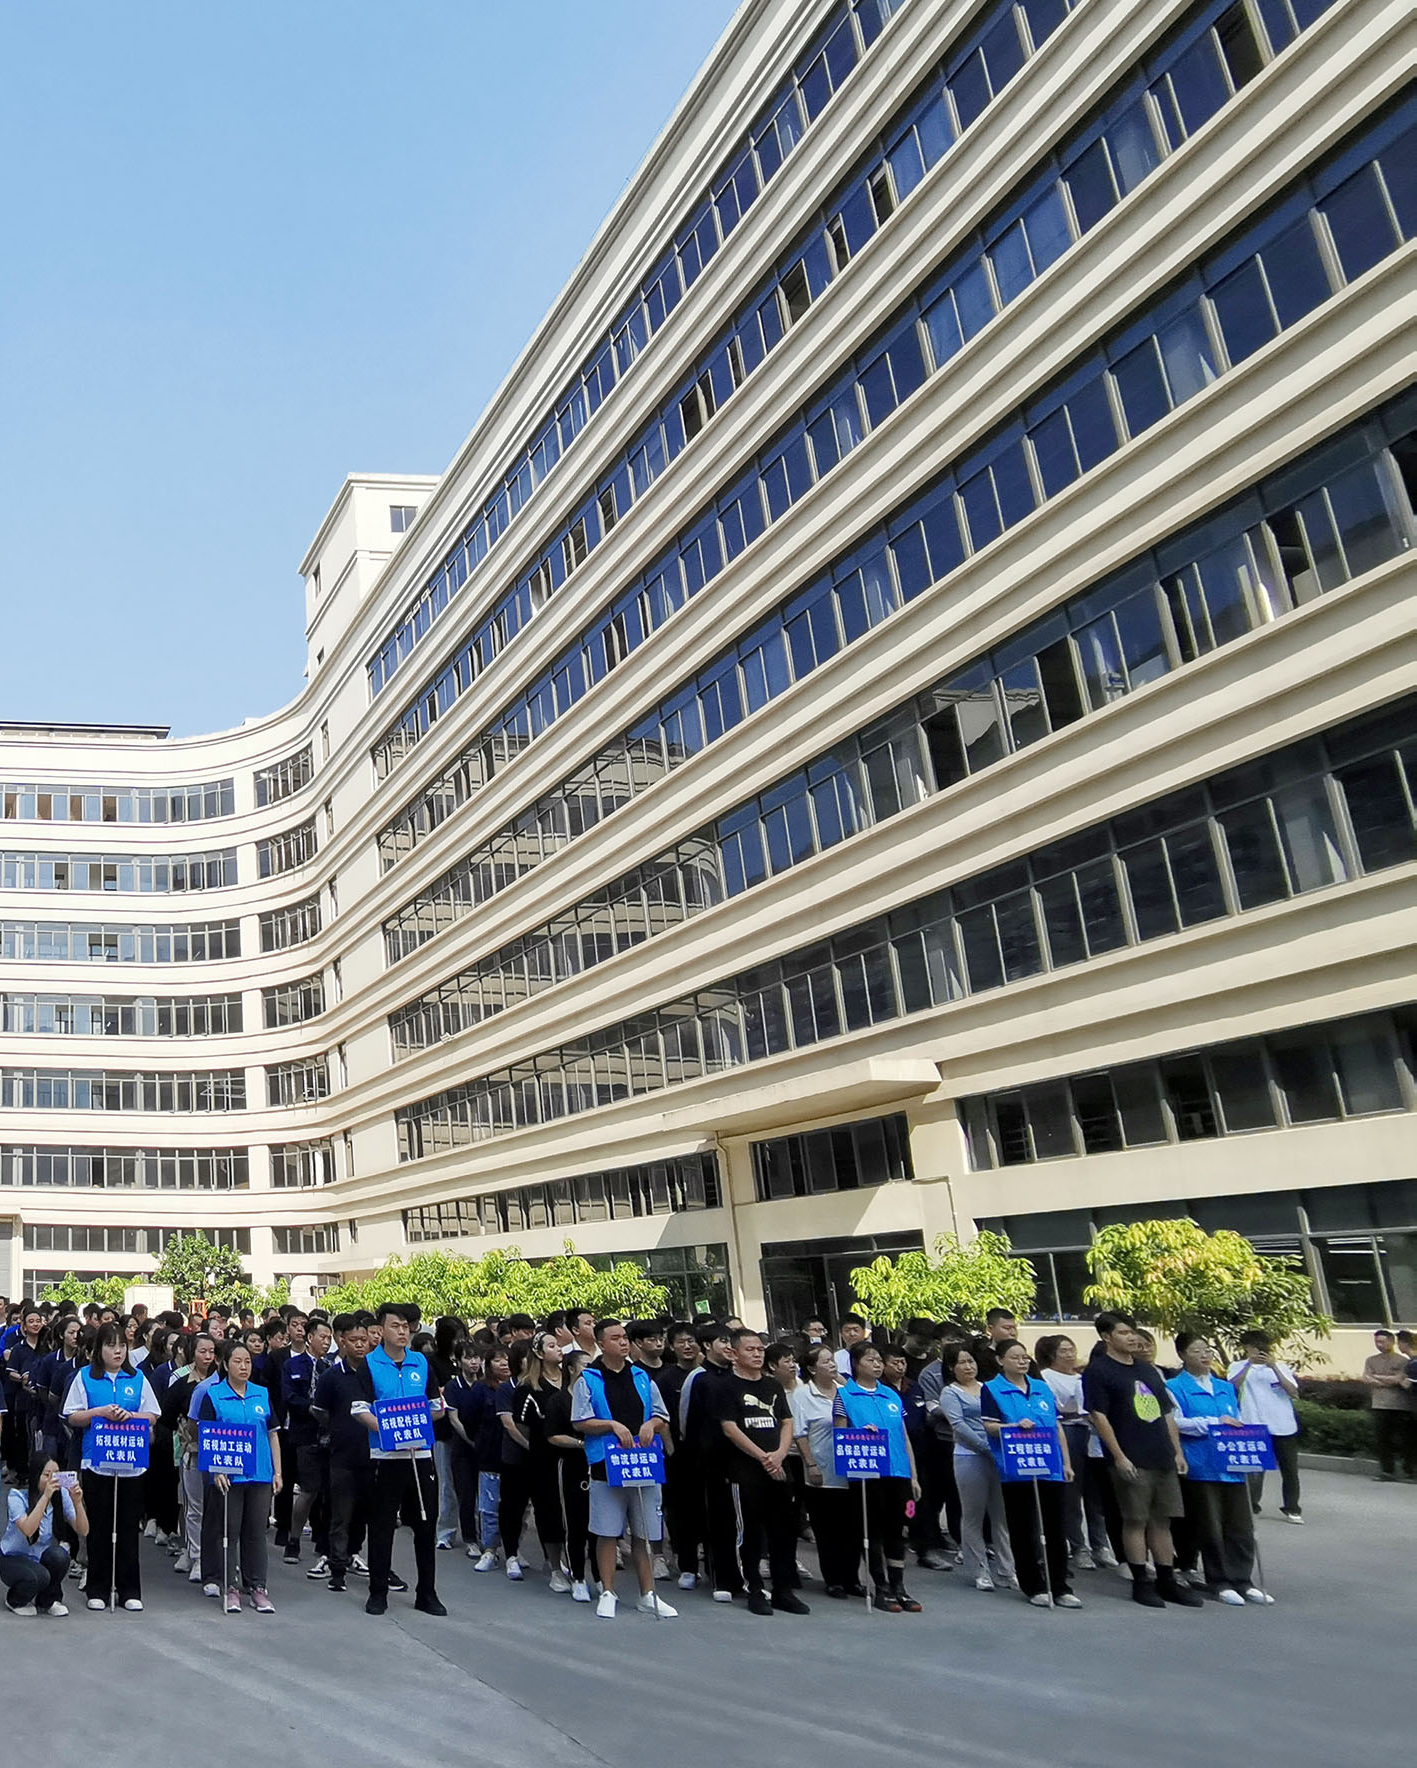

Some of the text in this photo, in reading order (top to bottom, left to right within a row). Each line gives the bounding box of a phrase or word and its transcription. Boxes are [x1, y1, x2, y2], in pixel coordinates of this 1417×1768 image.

[381, 1413, 427, 1431] 拓视配件运动
[96, 1434, 144, 1448] 拓视板材运动
[394, 1428, 424, 1442] 代表队
[203, 1439, 252, 1455] 拓视加工运动
[837, 1445, 886, 1456] 品保品管运动
[1008, 1443, 1051, 1454] 工程部运动
[106, 1450, 136, 1461] 代表队
[212, 1454, 243, 1468] 代表队
[611, 1453, 657, 1465] 物流部运动
[848, 1459, 878, 1468] 代表队
[1017, 1457, 1048, 1469] 代表队
[622, 1467, 652, 1478] 代表队
